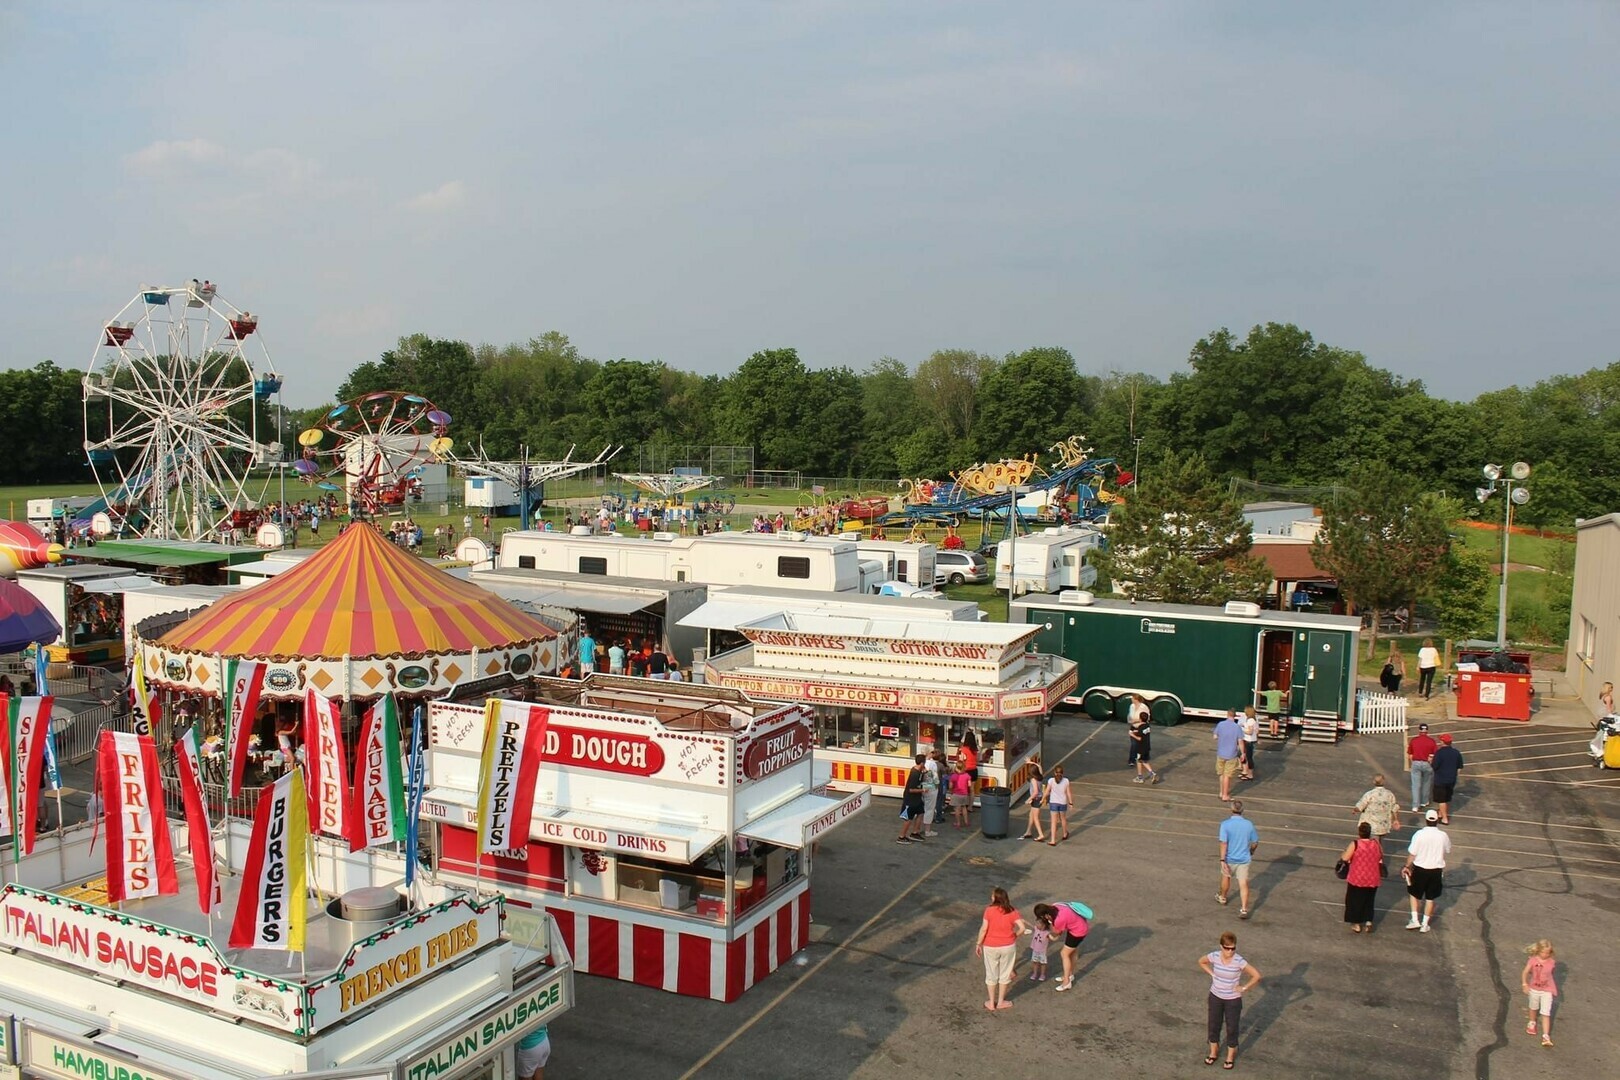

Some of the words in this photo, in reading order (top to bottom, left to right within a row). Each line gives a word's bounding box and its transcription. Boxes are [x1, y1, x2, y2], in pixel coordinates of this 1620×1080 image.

[974, 464, 1027, 490] COBRA
[758, 633, 799, 647] CANDY
[799, 637, 845, 650] APPLES
[854, 645, 885, 654] DRINKS
[890, 641, 941, 657] COTTON
[943, 645, 988, 660] CANDY
[724, 679, 763, 691] COTTON
[767, 683, 801, 694] CANDY
[813, 687, 891, 703] POPCORN
[904, 695, 941, 707] CANDY
[946, 698, 990, 711] APPLES
[446, 711, 460, 729] HOT
[453, 721, 474, 747] FRESH
[572, 734, 648, 768] DOUGH
[680, 742, 697, 759] HOT
[766, 729, 796, 756] FRUIT
[319, 711, 338, 828] FRIES
[686, 754, 713, 780] FRESH
[758, 743, 804, 777] TOPPINGS
[367, 716, 389, 840] SAUSAGE
[489, 721, 520, 846] PRETZELS
[121, 753, 150, 891] FRIES
[811, 811, 837, 837] FUNNEL
[841, 797, 862, 817] CAKES
[543, 822, 563, 837] ICE
[573, 827, 607, 844] COLD
[617, 833, 667, 853] DRINKS
[262, 797, 286, 943] BURGERS
[6, 904, 89, 958] ITALIAN
[97, 931, 218, 998] SAUSAGE
[339, 945, 422, 1013] FRENCH
[426, 918, 478, 968] FRIES
[482, 982, 560, 1046] SAUSAGE
